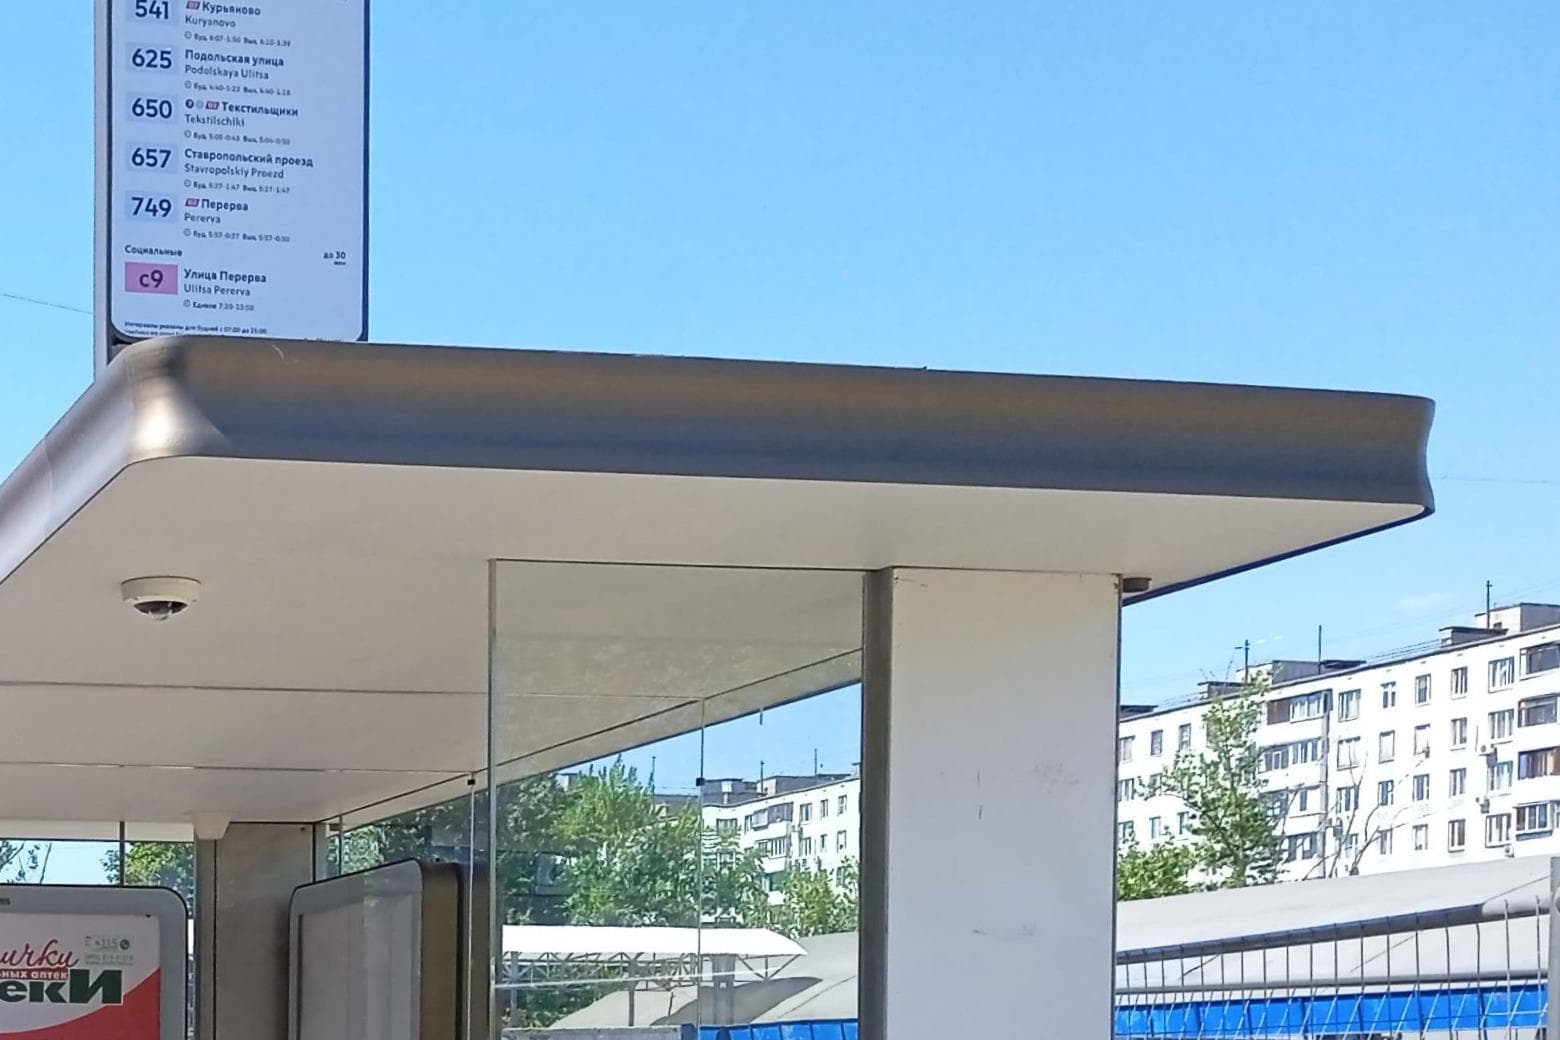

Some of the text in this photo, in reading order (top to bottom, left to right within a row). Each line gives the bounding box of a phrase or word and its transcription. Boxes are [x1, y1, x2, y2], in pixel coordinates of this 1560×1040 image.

[135, 0, 169, 20] 541
[202, 1, 261, 15] Курьяново
[185, 15, 236, 28] Kuryanovo
[131, 48, 172, 69] 625
[185, 49, 284, 67] Подольская улица
[185, 64, 269, 80] Podolskaya Ulitsa
[131, 97, 172, 119] 650
[221, 101, 299, 117] Текстильщики
[184, 113, 245, 127] Tekstilschiki
[131, 147, 172, 169] 657
[184, 148, 314, 168] Ставропольский проезд
[184, 163, 284, 179] Stavropolskiy Proezd
[131, 196, 172, 218] 749
[201, 198, 249, 212] Перерва
[184, 212, 221, 224] Pererva
[124, 244, 183, 257] Социальные
[335, 251, 346, 260] 30
[139, 269, 164, 288] с9
[184, 268, 267, 285] Улица Перерва
[184, 283, 251, 297] Ulitsa Pererva
[31, 970, 69, 980] аптек
